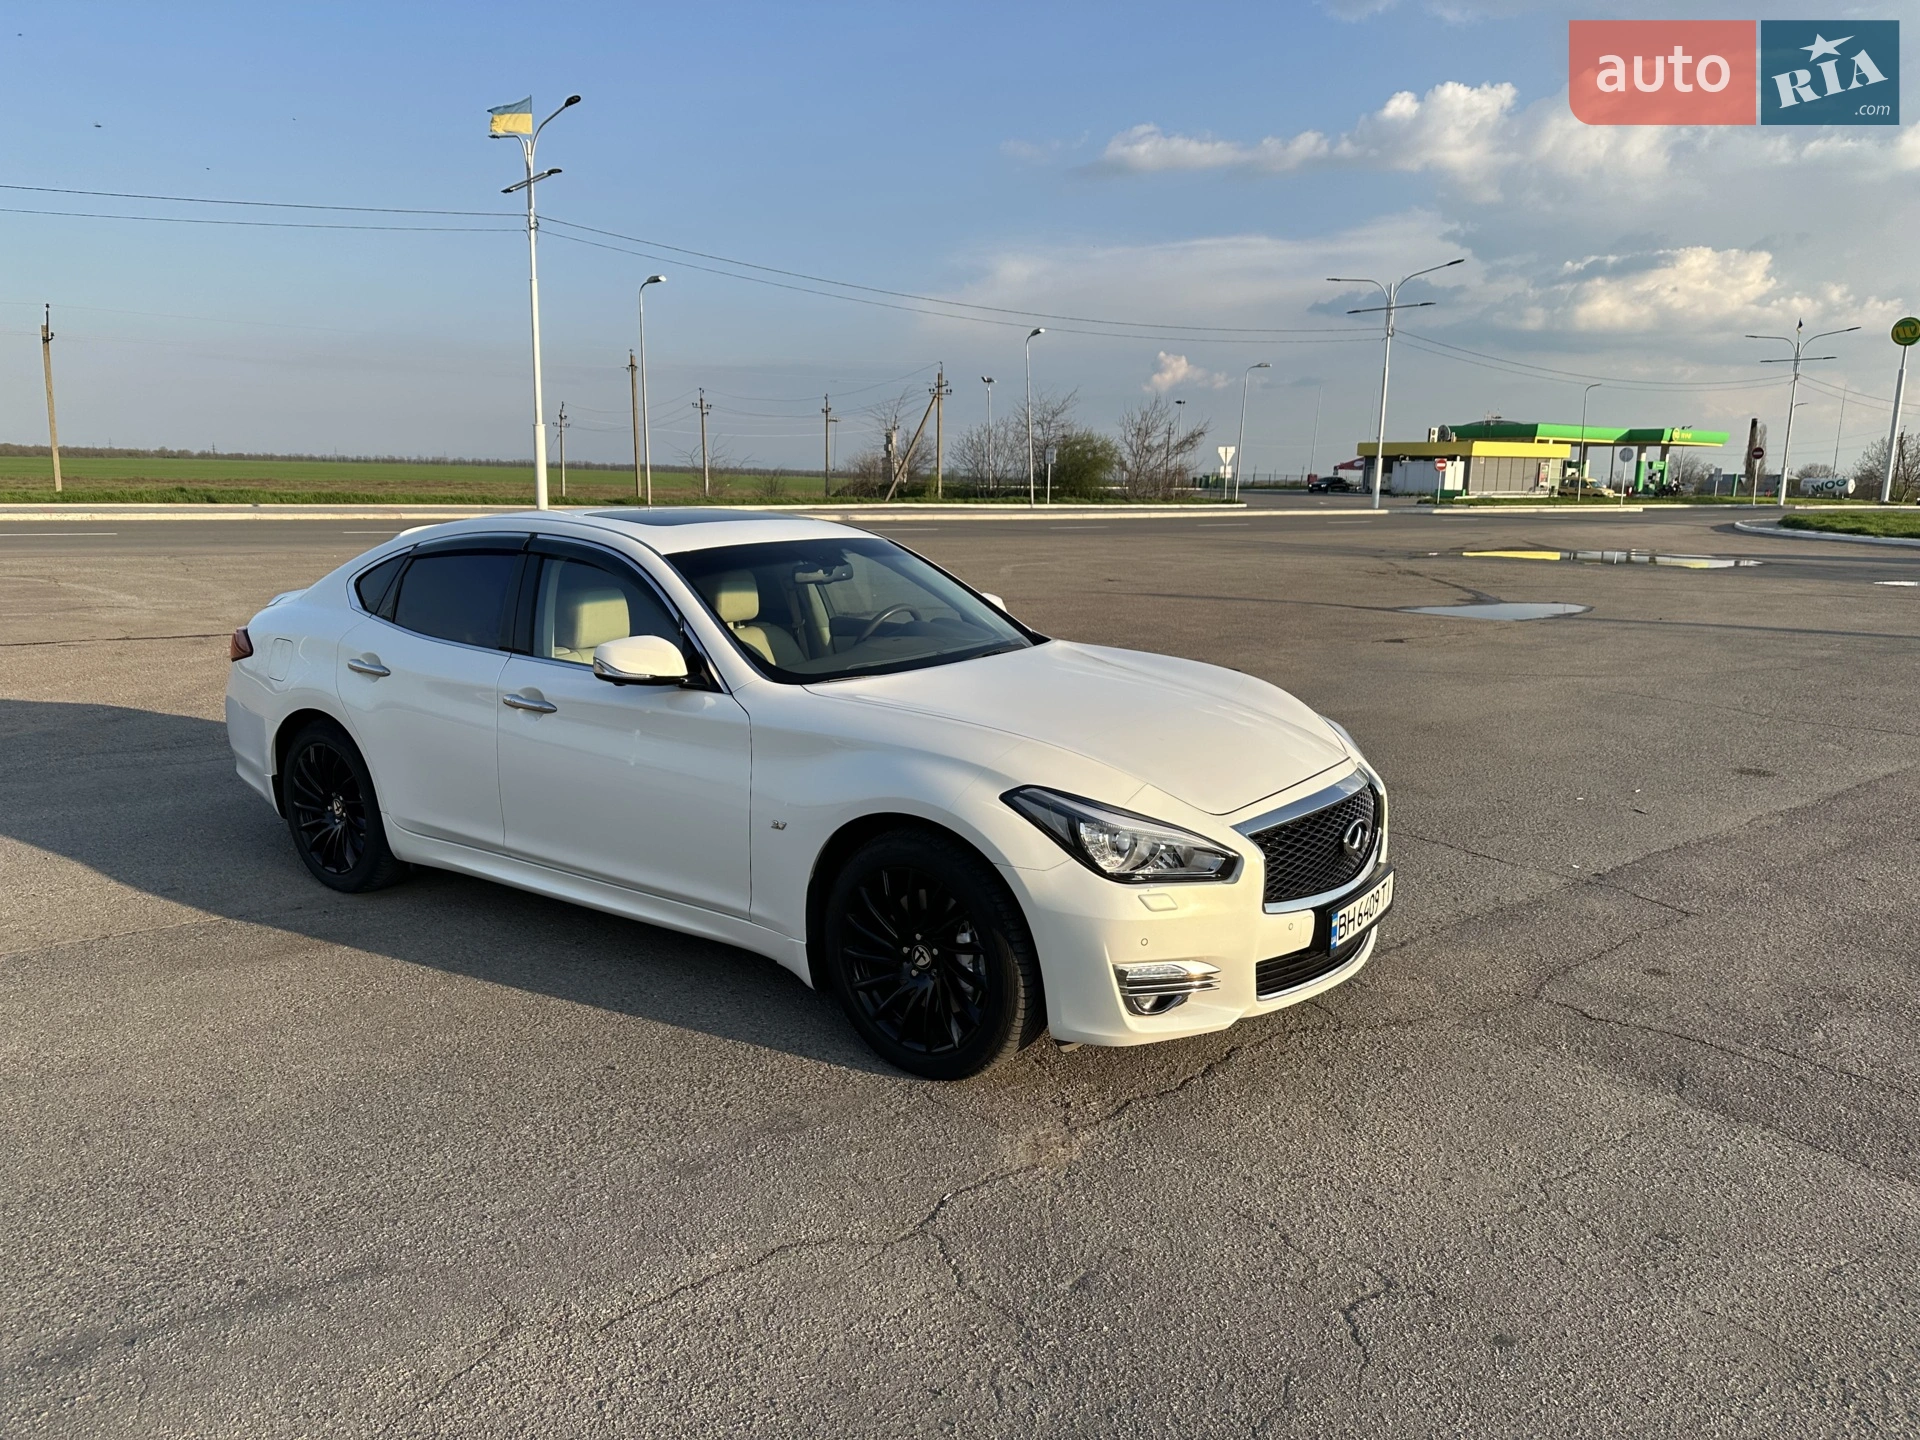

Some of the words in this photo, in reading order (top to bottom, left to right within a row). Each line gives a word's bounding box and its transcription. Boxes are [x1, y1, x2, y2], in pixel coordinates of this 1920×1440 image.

[1811, 478, 1847, 492] WOG
[1338, 906, 1356, 940] BH
[1357, 889, 1380, 927] 6409
